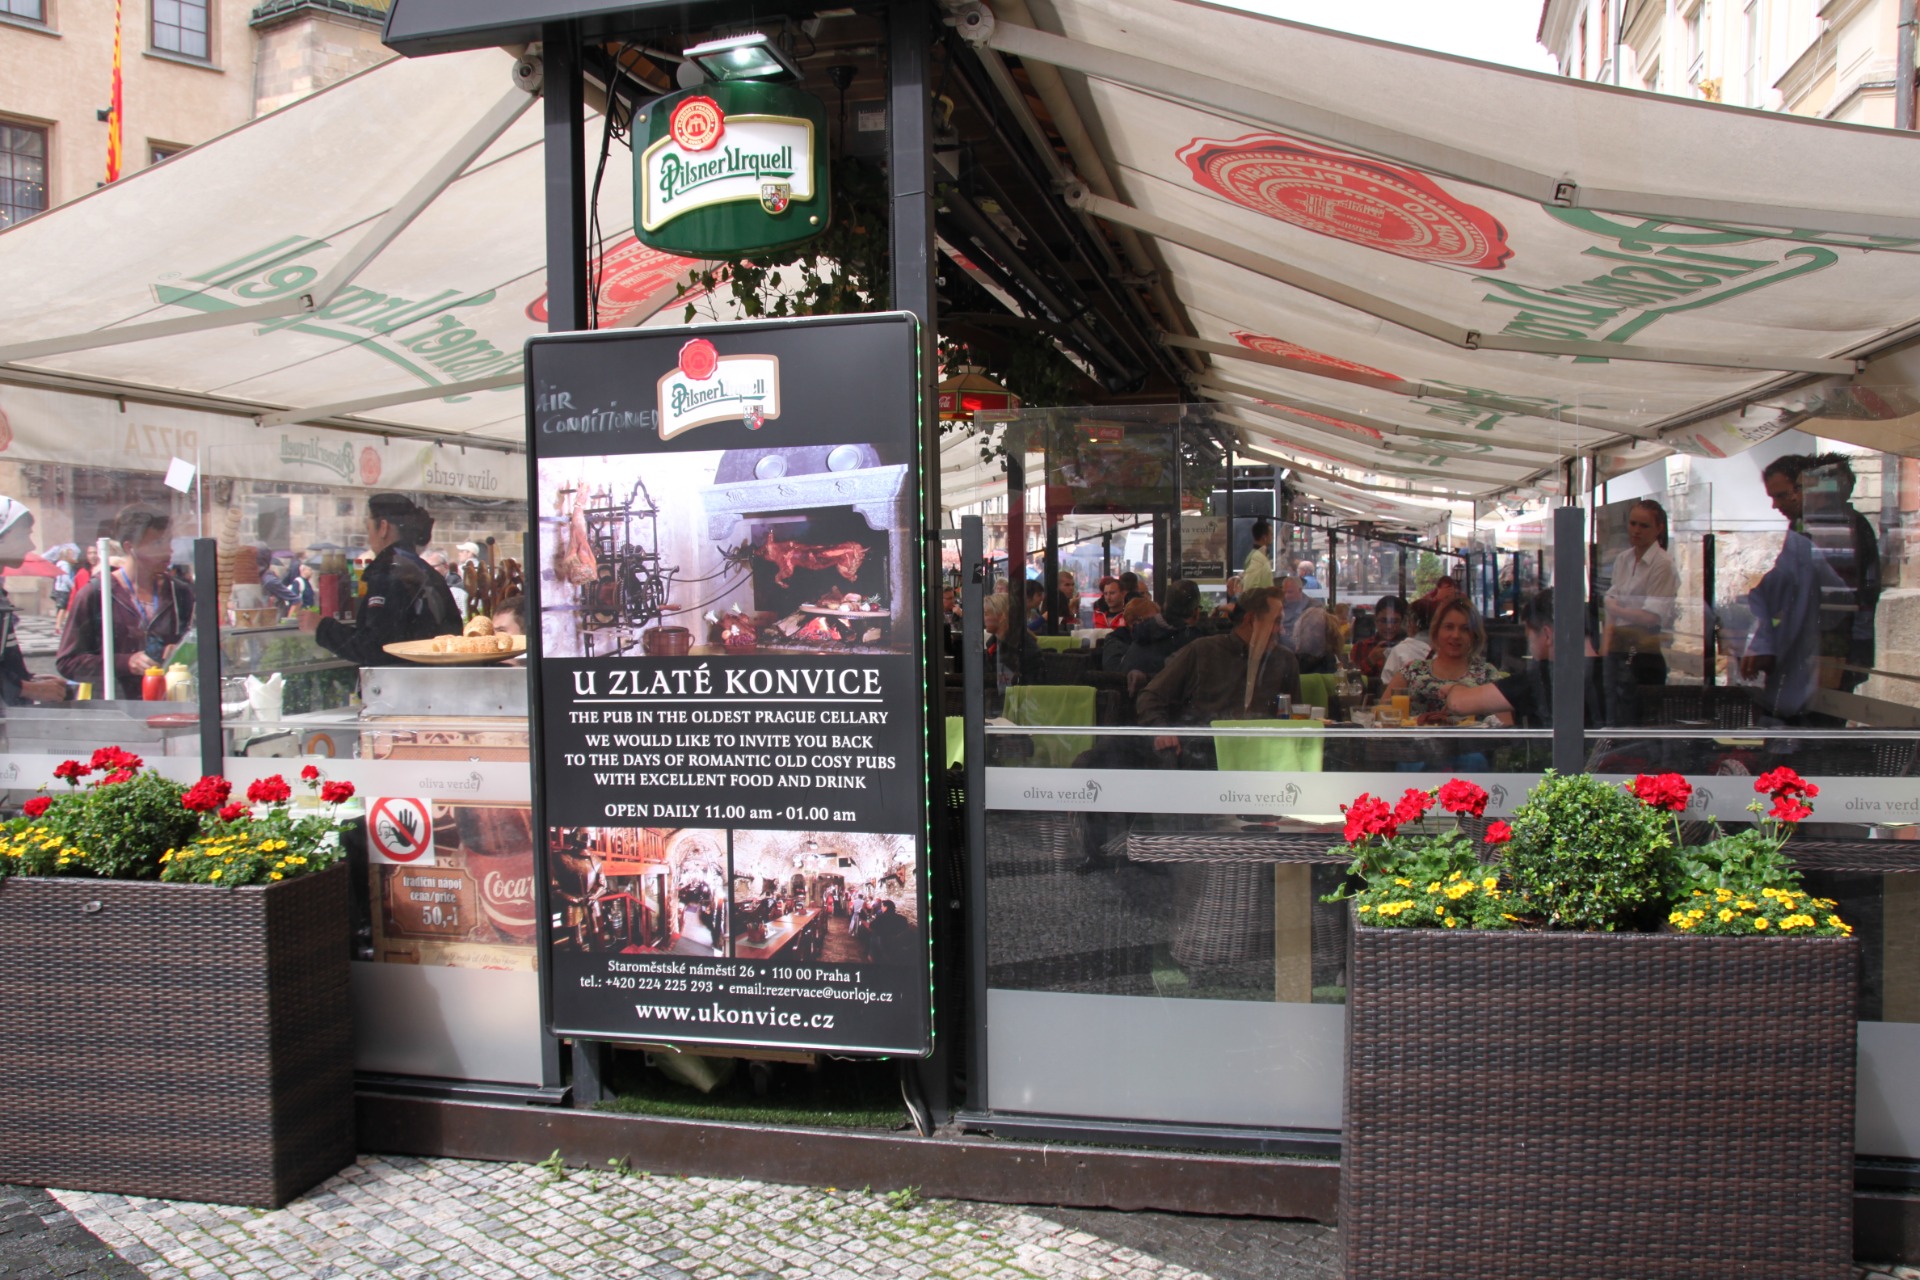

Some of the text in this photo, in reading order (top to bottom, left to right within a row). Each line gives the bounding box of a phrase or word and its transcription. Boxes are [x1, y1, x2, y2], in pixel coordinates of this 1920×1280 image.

[660, 145, 793, 203] Pilsner Urquell
[671, 382, 720, 417] Pilsner
[573, 662, 883, 696] U ZLATÉ KONVICE
[569, 711, 889, 725] THE PUB IN THE OLDEST PRAGUE CELLARY
[585, 734, 874, 749] WE WOULD LIKE TO INVITE YOU BACK
[564, 753, 897, 770] TO THE DAYS OF ROMANTIC OLD COSY PUBS
[418, 777, 477, 790] oliva verde
[594, 772, 867, 790] WITH EXCELLENT FOOD AND DRINK
[1023, 786, 1094, 801] oliva verde
[1219, 789, 1293, 804] oliva verde
[604, 803, 649, 818] OPEN
[653, 804, 700, 819] DAILY
[704, 804, 746, 820] 11.00
[749, 808, 773, 820] am
[785, 806, 829, 821] 01.00
[832, 810, 857, 822] am
[1845, 796, 1920, 812] oliva verd
[438, 877, 463, 891] nápoj
[410, 891, 457, 904] cena/price
[607, 959, 861, 984] Staroměstské náměstí 26 110 00 Praha 1
[580, 974, 893, 1004] tel.: +420 224 225 293 email:rezervace@uorloje.cz
[635, 1002, 835, 1029] www.ukonvice.cz
